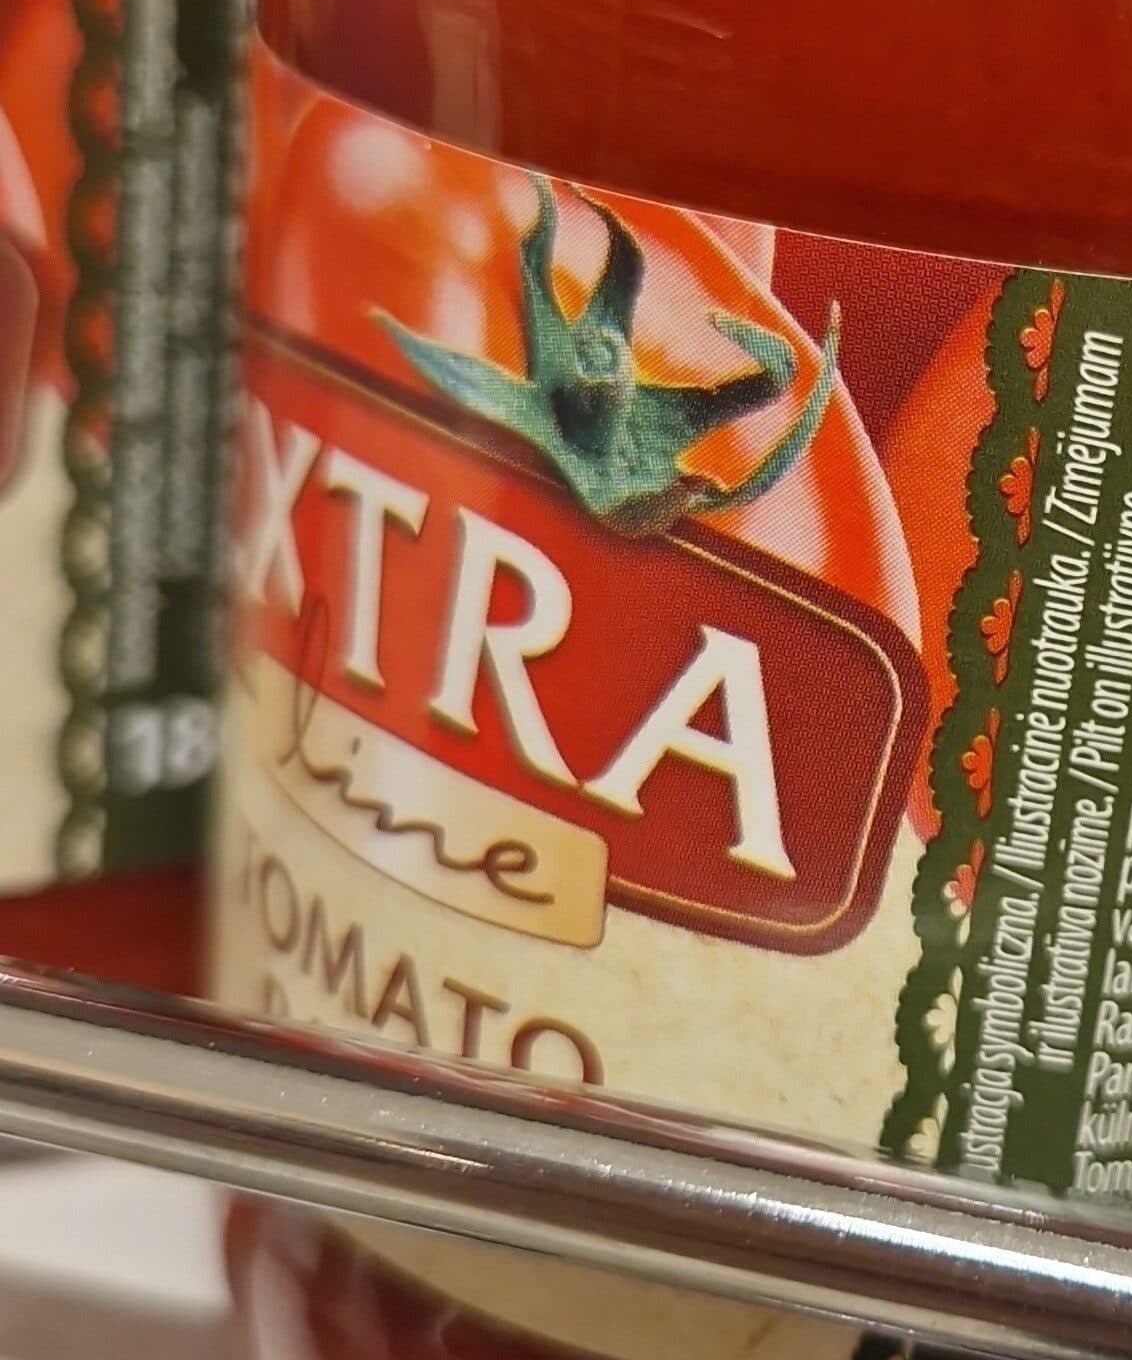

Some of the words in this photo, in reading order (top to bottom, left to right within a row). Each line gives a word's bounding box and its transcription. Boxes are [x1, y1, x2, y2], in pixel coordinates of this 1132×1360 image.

[1044, 329, 1124, 525] Zīmējumam
[1042, 519, 1095, 547] /
[1031, 551, 1092, 713] nuotrauka.
[1069, 719, 1126, 772] Pilt
[1091, 681, 1132, 721] on
[1058, 796, 1115, 905] nozīme.
[973, 892, 1041, 1068] symboliczna.
[1029, 905, 1097, 1045] ilustratīva
